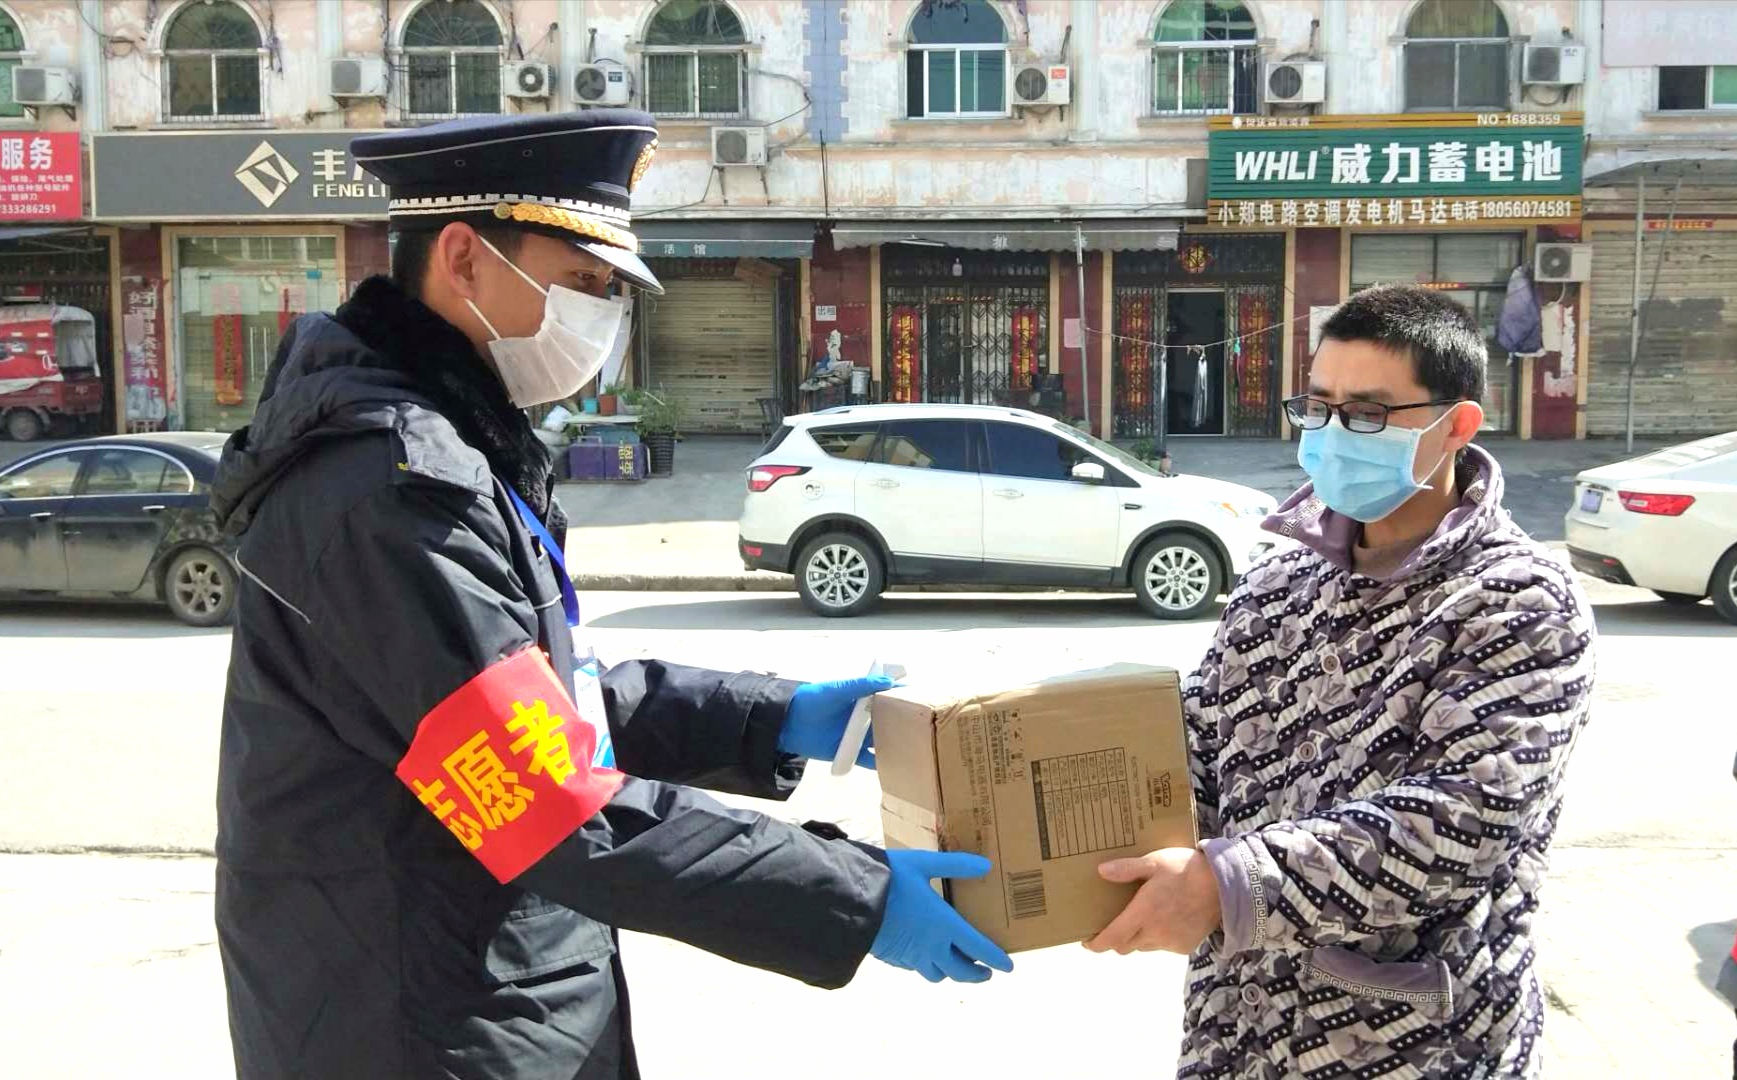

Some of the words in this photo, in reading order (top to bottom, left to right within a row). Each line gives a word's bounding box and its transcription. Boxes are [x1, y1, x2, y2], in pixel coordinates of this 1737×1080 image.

[1, 136, 54, 171] 服务
[312, 149, 379, 181] 丰
[1235, 150, 1318, 181] WHLI
[1331, 140, 1563, 184] 威力蓄电池
[0, 203, 56, 214] 333286291
[412, 698, 577, 850] 志愿者
